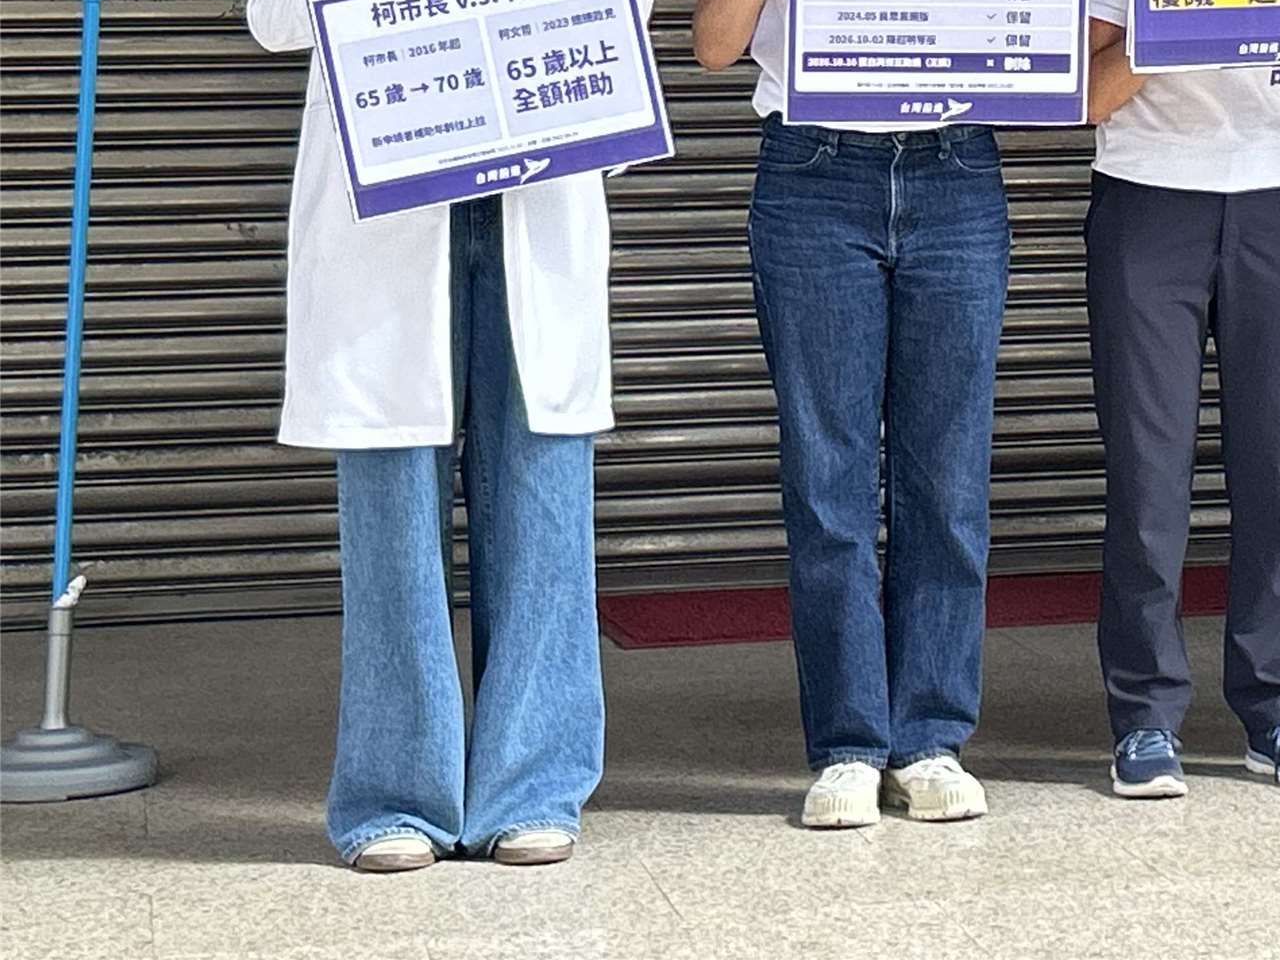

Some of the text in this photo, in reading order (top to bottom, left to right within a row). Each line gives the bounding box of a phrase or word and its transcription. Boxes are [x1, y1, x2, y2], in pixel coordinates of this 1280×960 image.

[542, 17, 570, 32] 2023
[408, 43, 437, 58] 2016
[506, 40, 619, 81] 65 歲以上
[355, 67, 485, 109] 65 歲 70 歲
[512, 71, 614, 114] 全額補助
